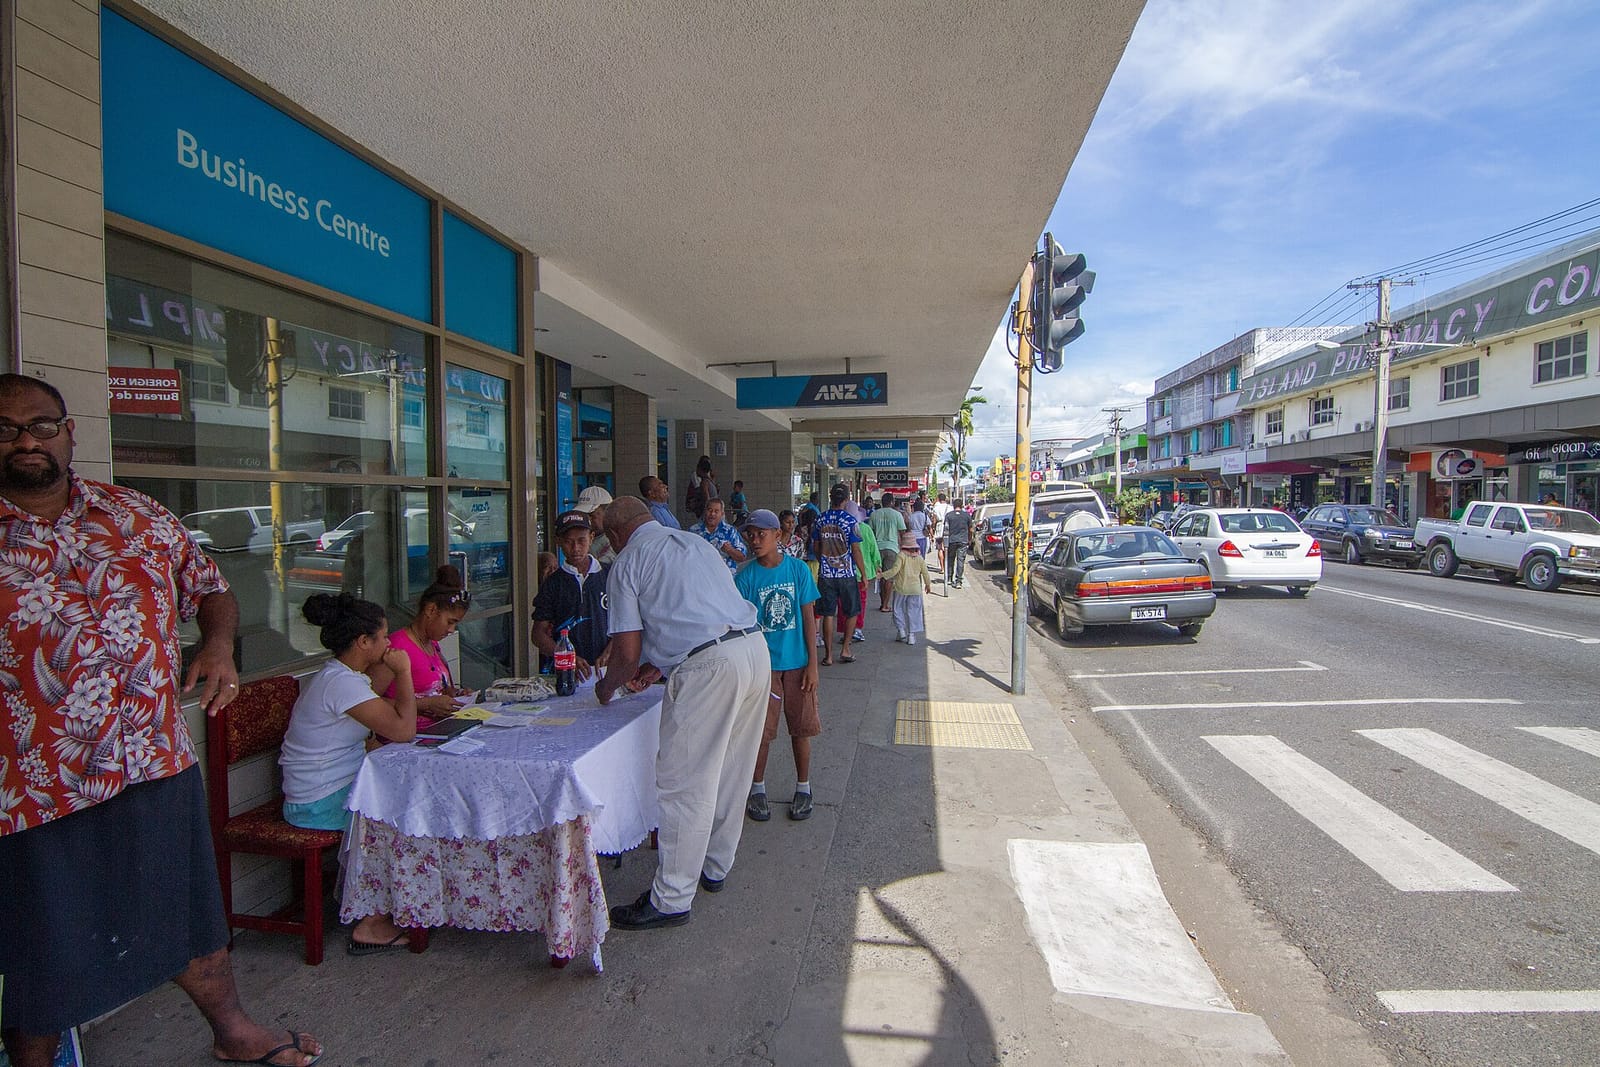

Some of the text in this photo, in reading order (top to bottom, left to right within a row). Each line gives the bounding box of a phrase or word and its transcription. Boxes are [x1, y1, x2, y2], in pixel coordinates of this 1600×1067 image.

[177, 128, 390, 257] Business Centre
[814, 384, 858, 401] ANZ
[1249, 360, 1317, 400] ISLAND
[1526, 264, 1600, 315] CO
